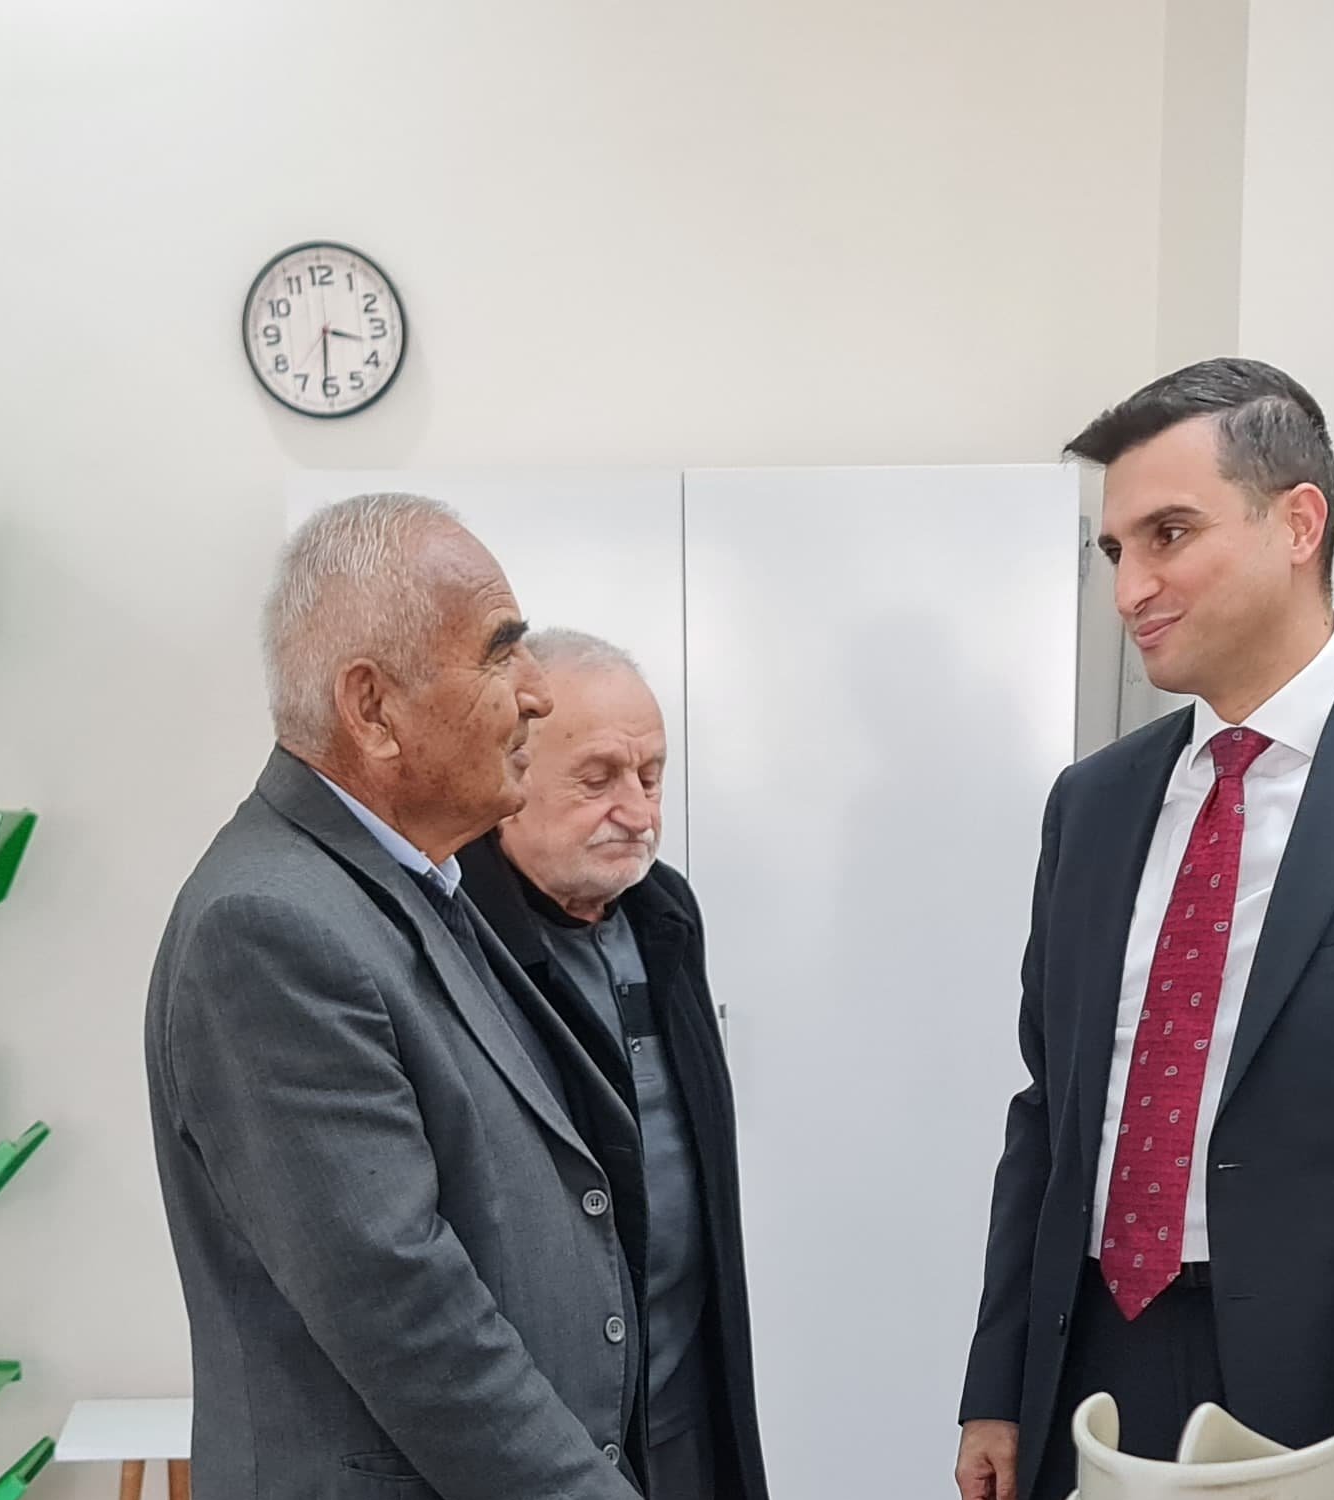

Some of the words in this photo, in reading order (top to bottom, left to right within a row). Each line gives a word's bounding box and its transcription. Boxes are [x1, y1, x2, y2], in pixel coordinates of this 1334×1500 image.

[286, 275, 302, 295] 11
[308, 265, 334, 286] 12
[347, 272, 354, 292] 1
[268, 298, 291, 318] 10
[363, 293, 378, 313] 2
[263, 324, 281, 346] 9
[369, 318, 387, 340] 3
[275, 354, 289, 373] 8
[365, 350, 380, 368] 4
[294, 373, 309, 392] 7
[323, 376, 340, 398] 6
[349, 371, 364, 390] 5
